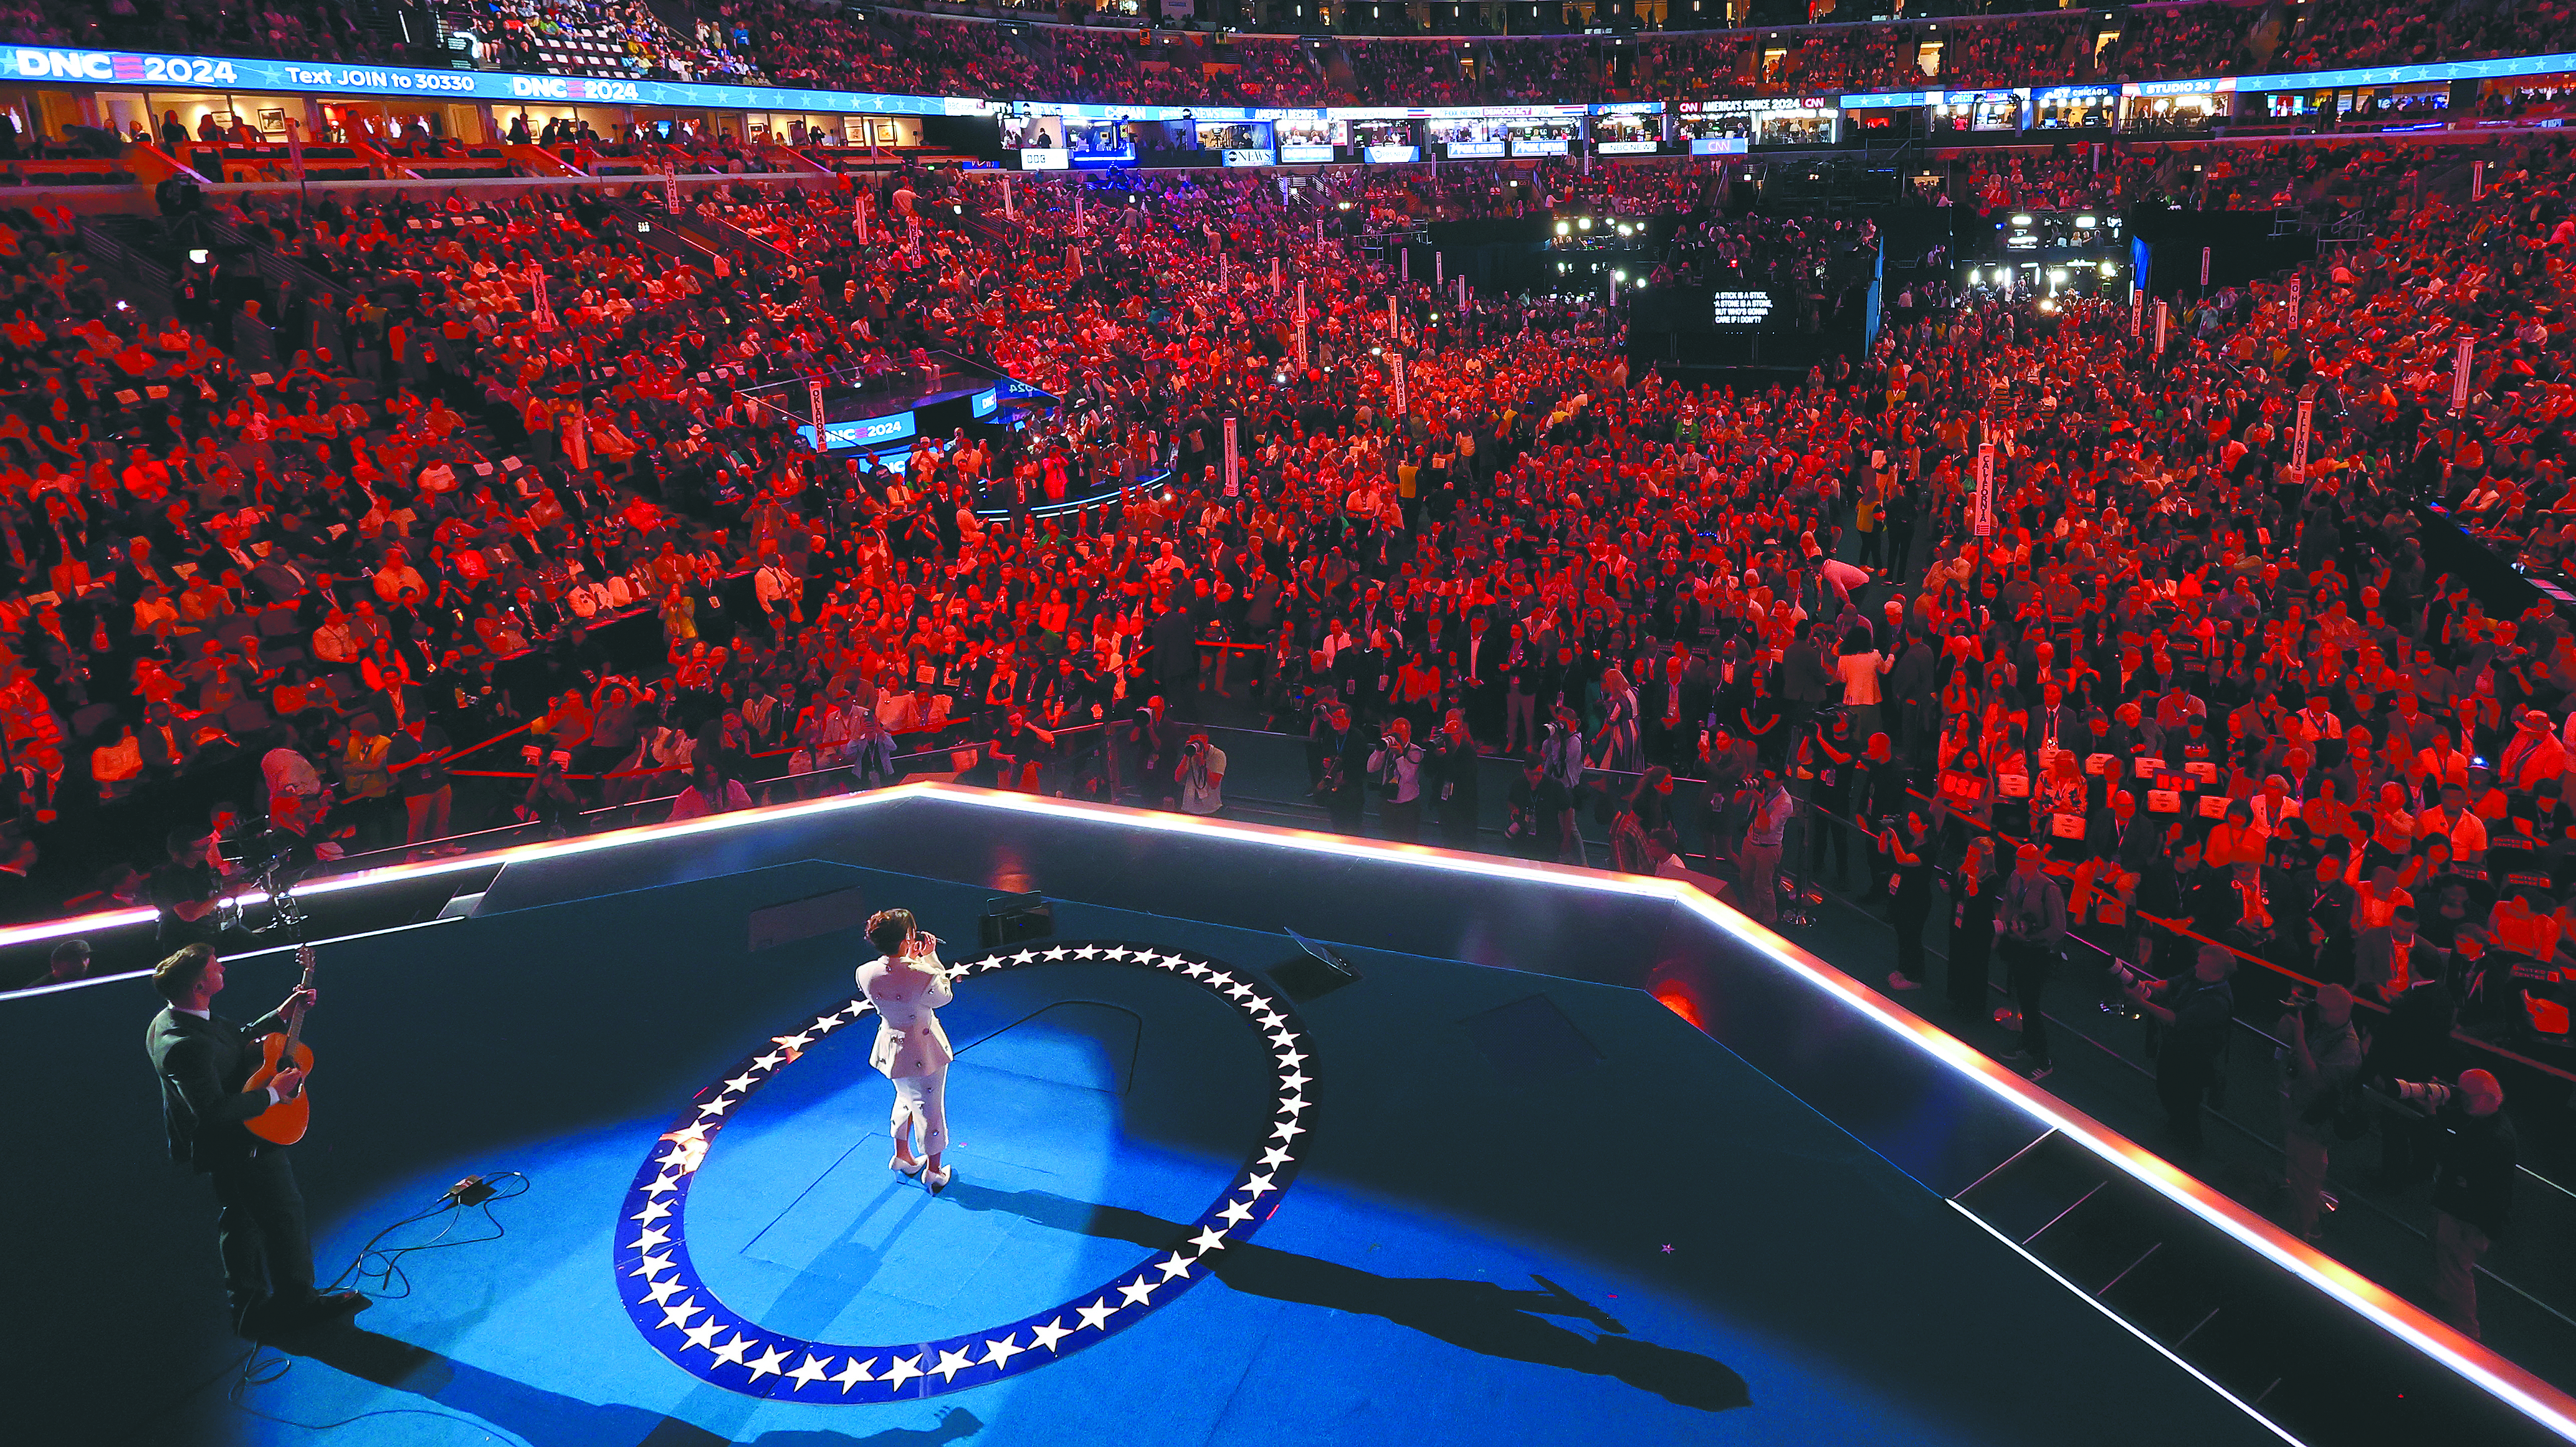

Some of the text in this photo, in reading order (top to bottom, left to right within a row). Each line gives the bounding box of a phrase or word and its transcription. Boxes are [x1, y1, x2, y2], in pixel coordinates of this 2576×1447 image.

[145, 59, 237, 84] 2024
[284, 67, 474, 92] Text JOIN to 30330
[586, 80, 639, 100] 2024
[2072, 88, 2109, 97] CHICAGO
[2146, 81, 2211, 94] STUDIO 24
[1611, 103, 1652, 114] MSNBC
[1679, 98, 1825, 112] CNN AMERICA'S CHOICE 2024 CNN
[1104, 106, 1146, 120] C-SPAN
[1191, 108, 1219, 120] NEWS
[1707, 141, 1731, 152] CNN
[1238, 150, 1271, 161] NEWS
[1720, 292, 1737, 300] STICK
[2290, 285, 2299, 323] OHIO
[1396, 361, 1405, 406] DELAWARE
[812, 389, 826, 443] OKLAHOMA
[867, 421, 902, 437] 2024
[1979, 455, 1990, 523] CALIFORNIA
[1944, 775, 1980, 800] USA
